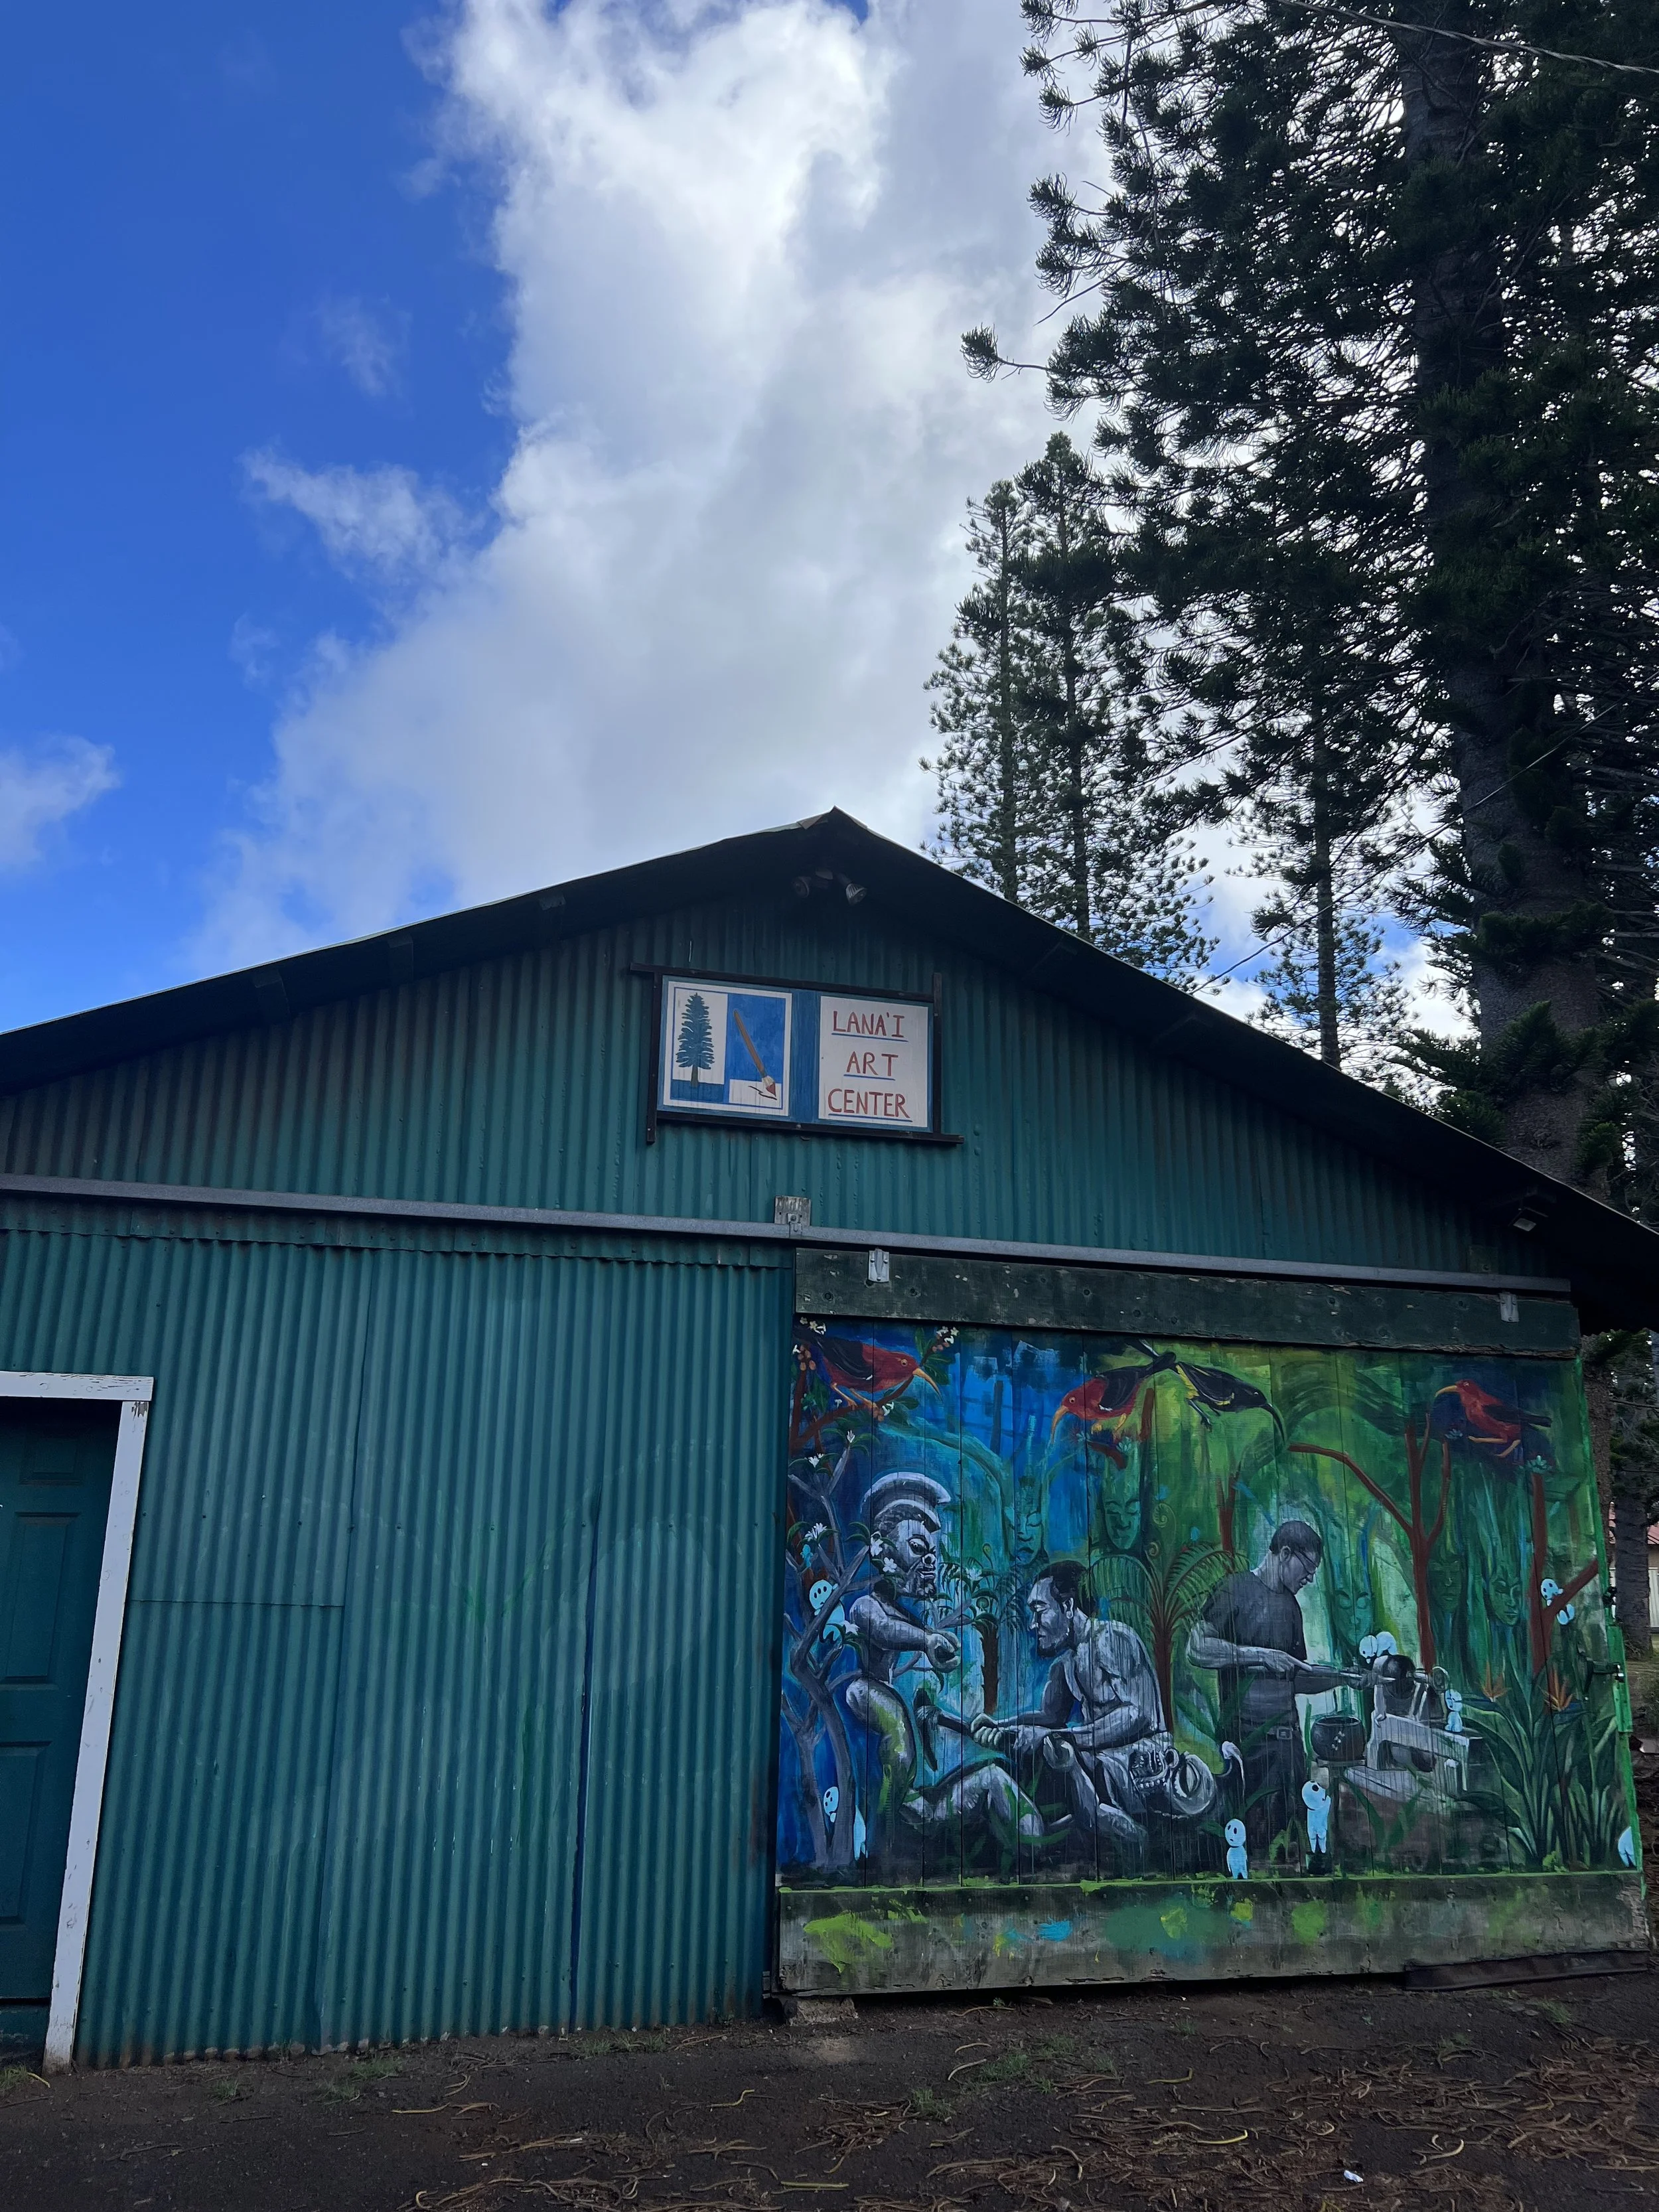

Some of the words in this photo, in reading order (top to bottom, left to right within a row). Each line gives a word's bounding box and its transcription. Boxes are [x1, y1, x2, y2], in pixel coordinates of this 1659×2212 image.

[833, 1010, 904, 1037] LANA'I
[846, 1051, 899, 1076] ART
[828, 1088, 910, 1118] CENTER
